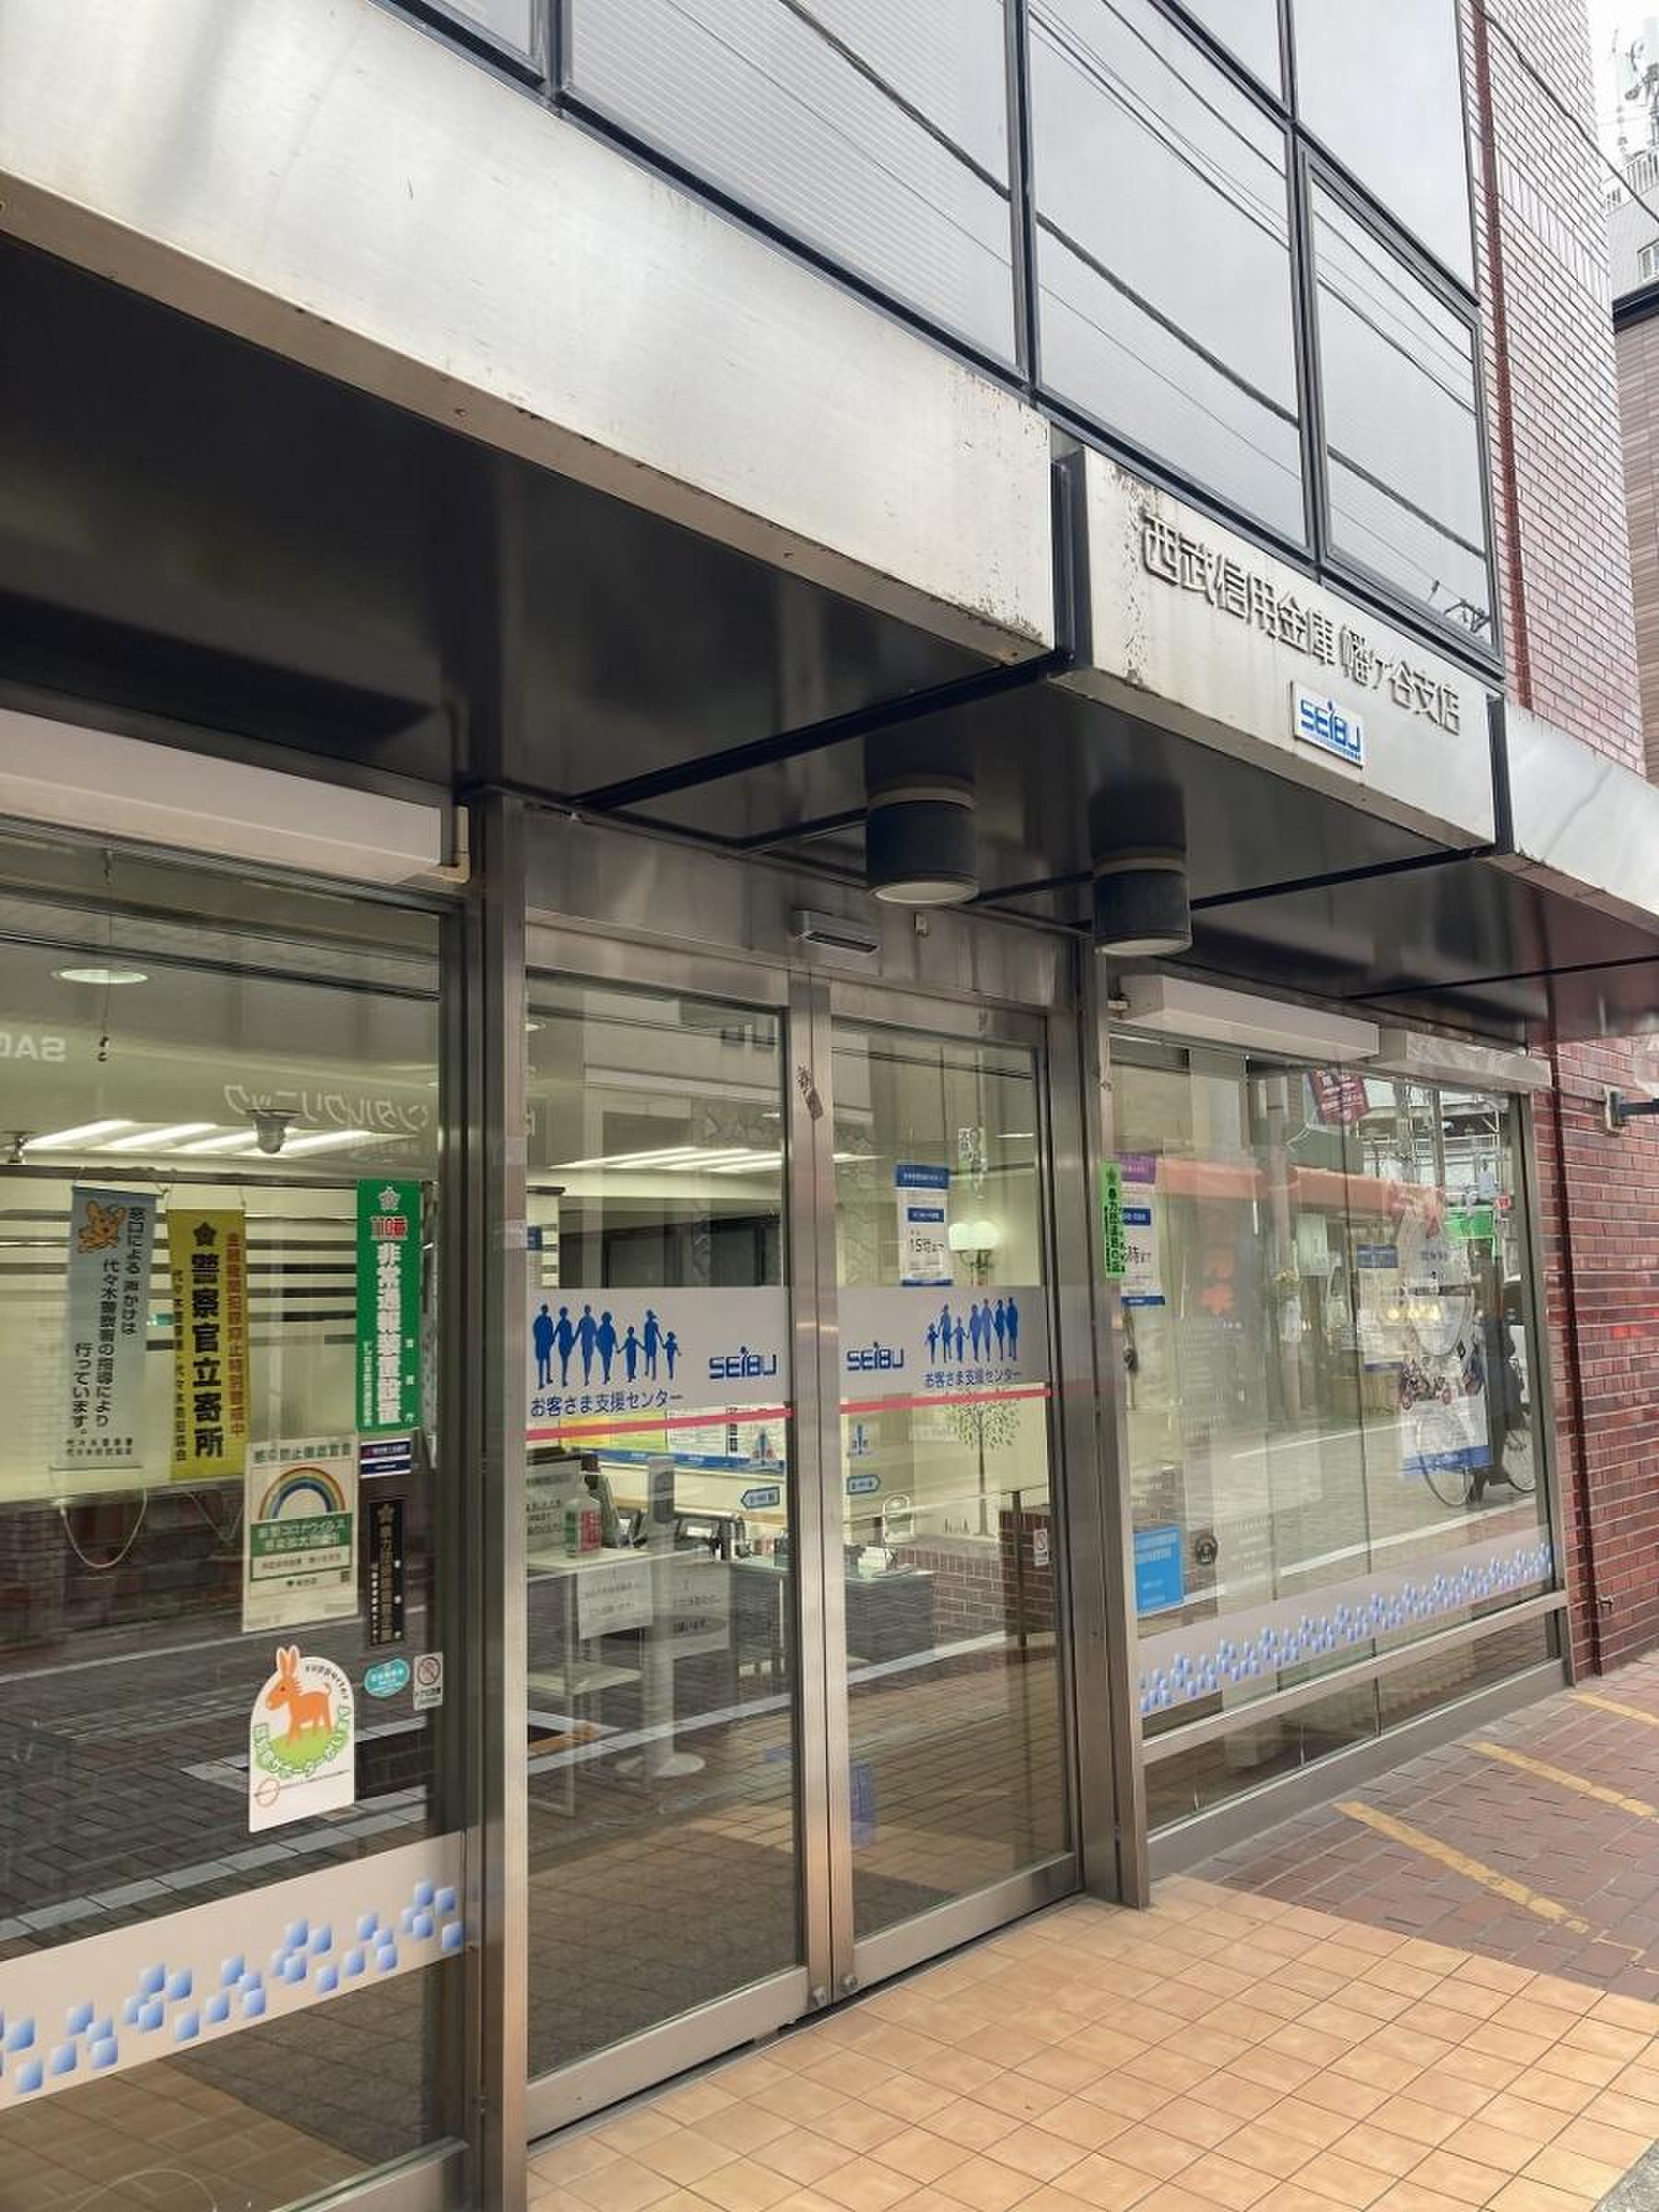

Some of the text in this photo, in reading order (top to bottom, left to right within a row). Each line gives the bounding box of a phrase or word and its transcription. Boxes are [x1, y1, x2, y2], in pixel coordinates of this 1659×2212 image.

[1141, 514, 1335, 667] 西武信用金庫
[192, 1253, 224, 1458] 警察官立寄所
[709, 1346, 776, 1380] SEIBU
[847, 1341, 904, 1371] SEIBU
[924, 1368, 1023, 1389] お客さま支援センター
[530, 1389, 683, 1417] お客さま支援センター
